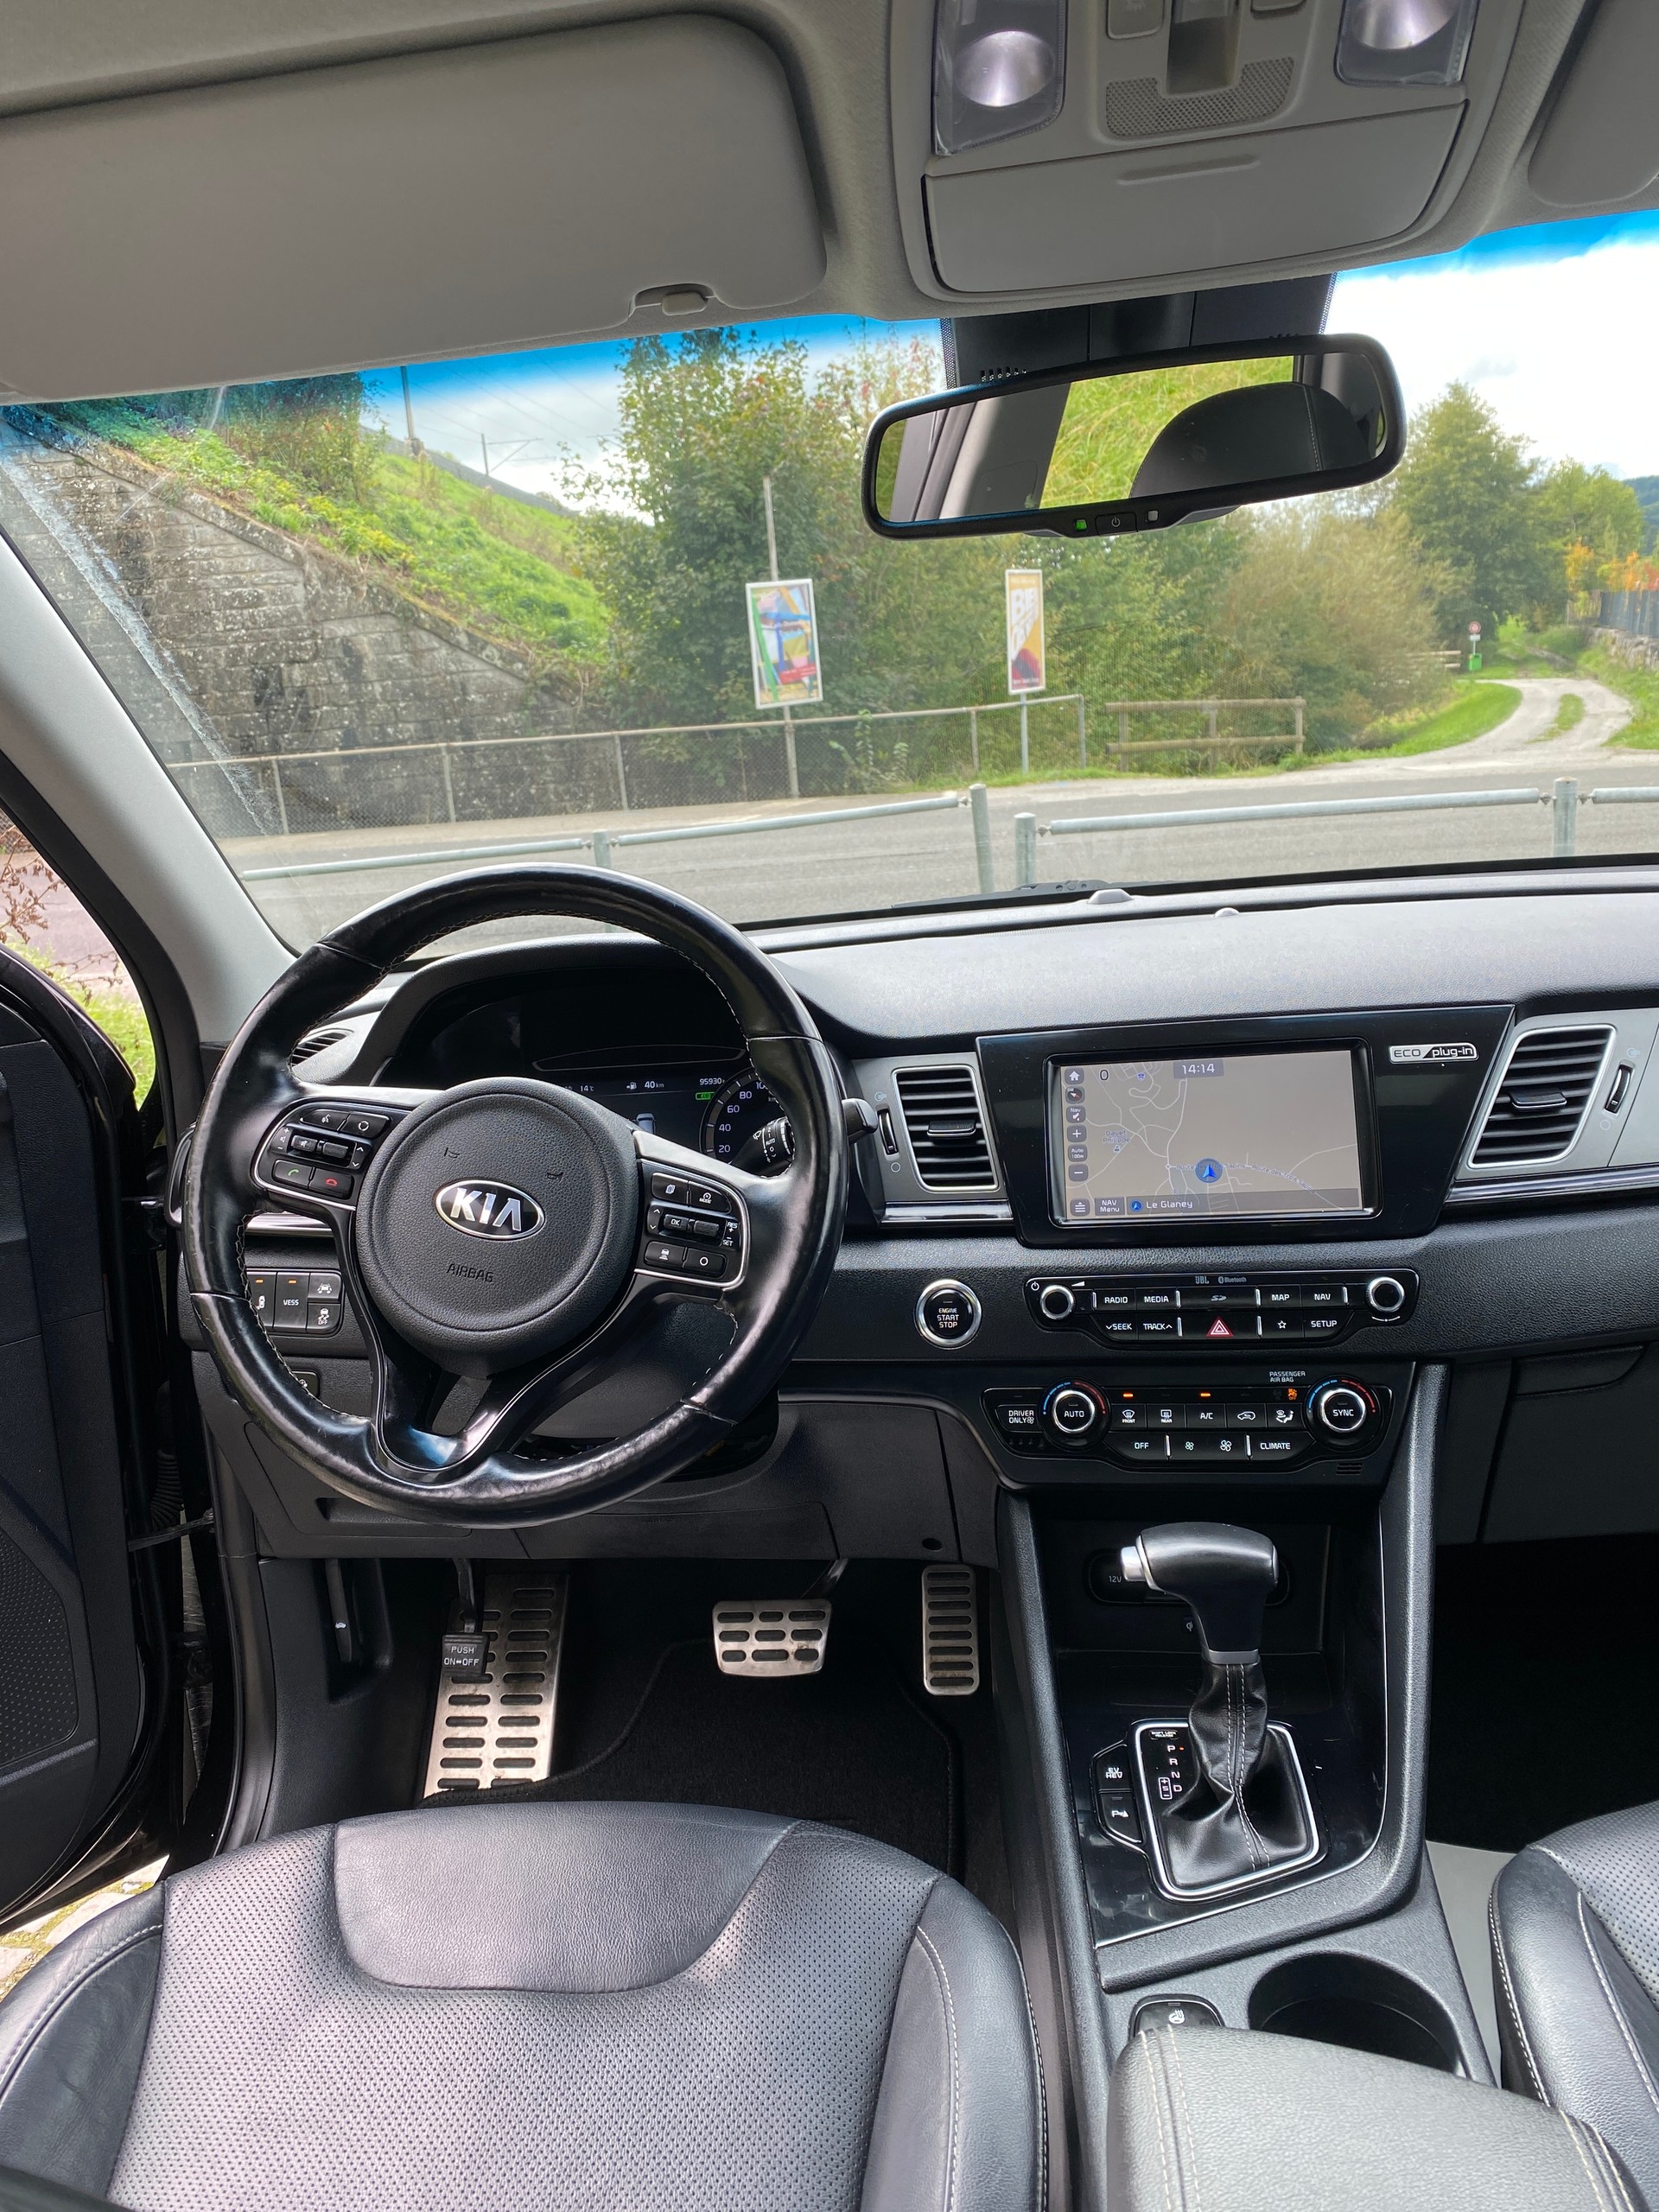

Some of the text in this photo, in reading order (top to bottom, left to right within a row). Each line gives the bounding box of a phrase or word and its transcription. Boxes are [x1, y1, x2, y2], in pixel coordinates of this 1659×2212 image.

[1394, 1046, 1473, 1058] ECO plug-in
[1182, 1064, 1215, 1074] 14:14
[1099, 1069, 1109, 1081] 0
[1252, 1164, 1270, 1173] Route
[449, 1187, 522, 1232] KIA
[1160, 1200, 1193, 1210] Glaney
[447, 1263, 493, 1282] AIRBAG
[1195, 1275, 1210, 1284] JBL
